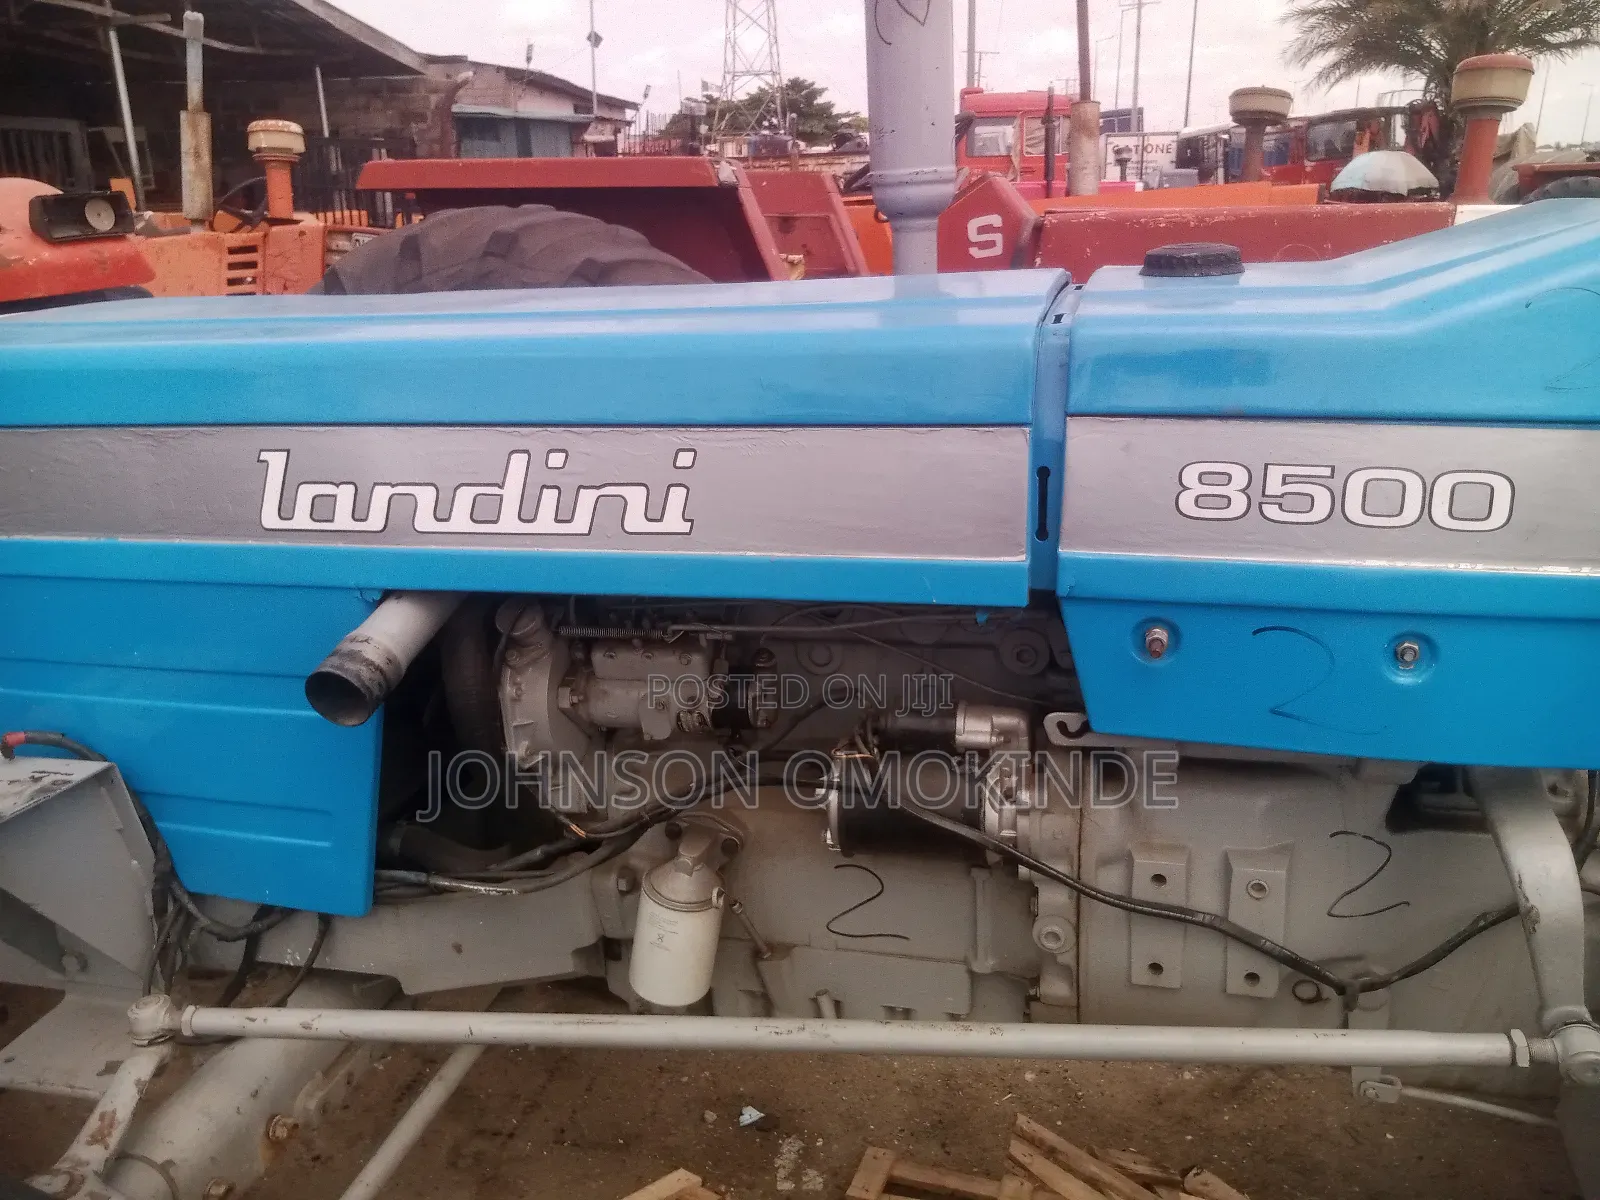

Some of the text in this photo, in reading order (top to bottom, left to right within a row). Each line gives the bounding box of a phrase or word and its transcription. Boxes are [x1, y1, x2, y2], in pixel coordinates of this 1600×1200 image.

[967, 214, 1003, 259] S
[1175, 460, 1515, 533] 8500
[826, 864, 910, 940] 2
[1327, 830, 1410, 918] 2
